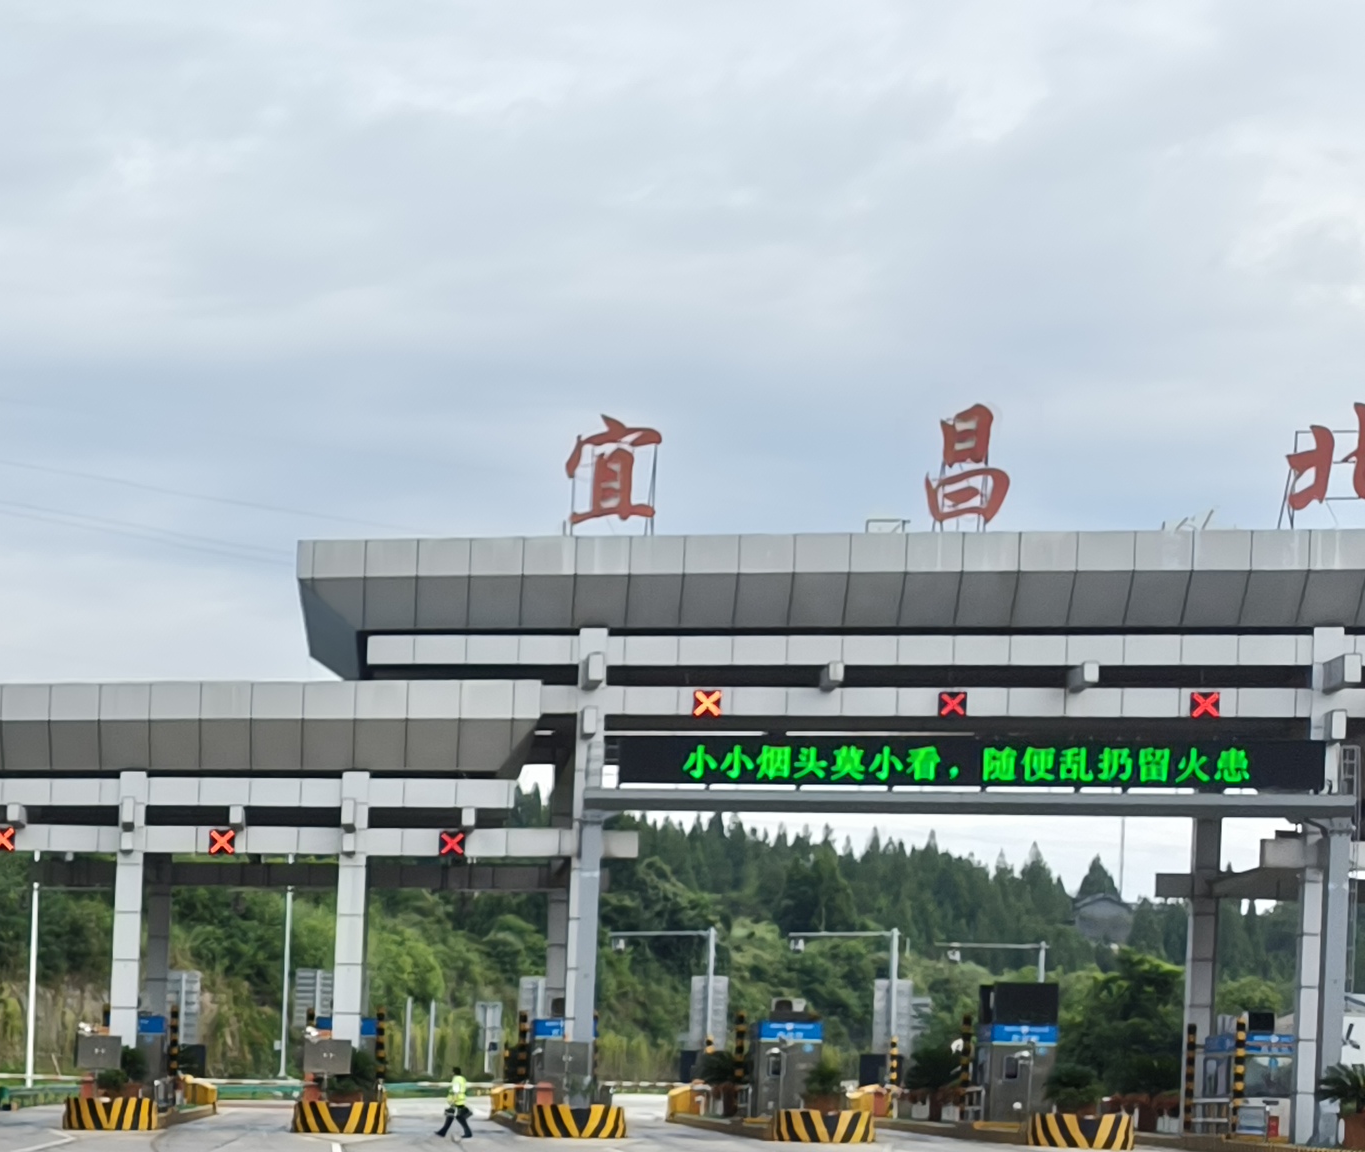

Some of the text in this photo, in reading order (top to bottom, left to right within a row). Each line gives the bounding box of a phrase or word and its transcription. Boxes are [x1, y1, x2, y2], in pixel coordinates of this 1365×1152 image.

[683, 745, 1249, 783] 小小烟头莫小看，随便乱扔留火患
